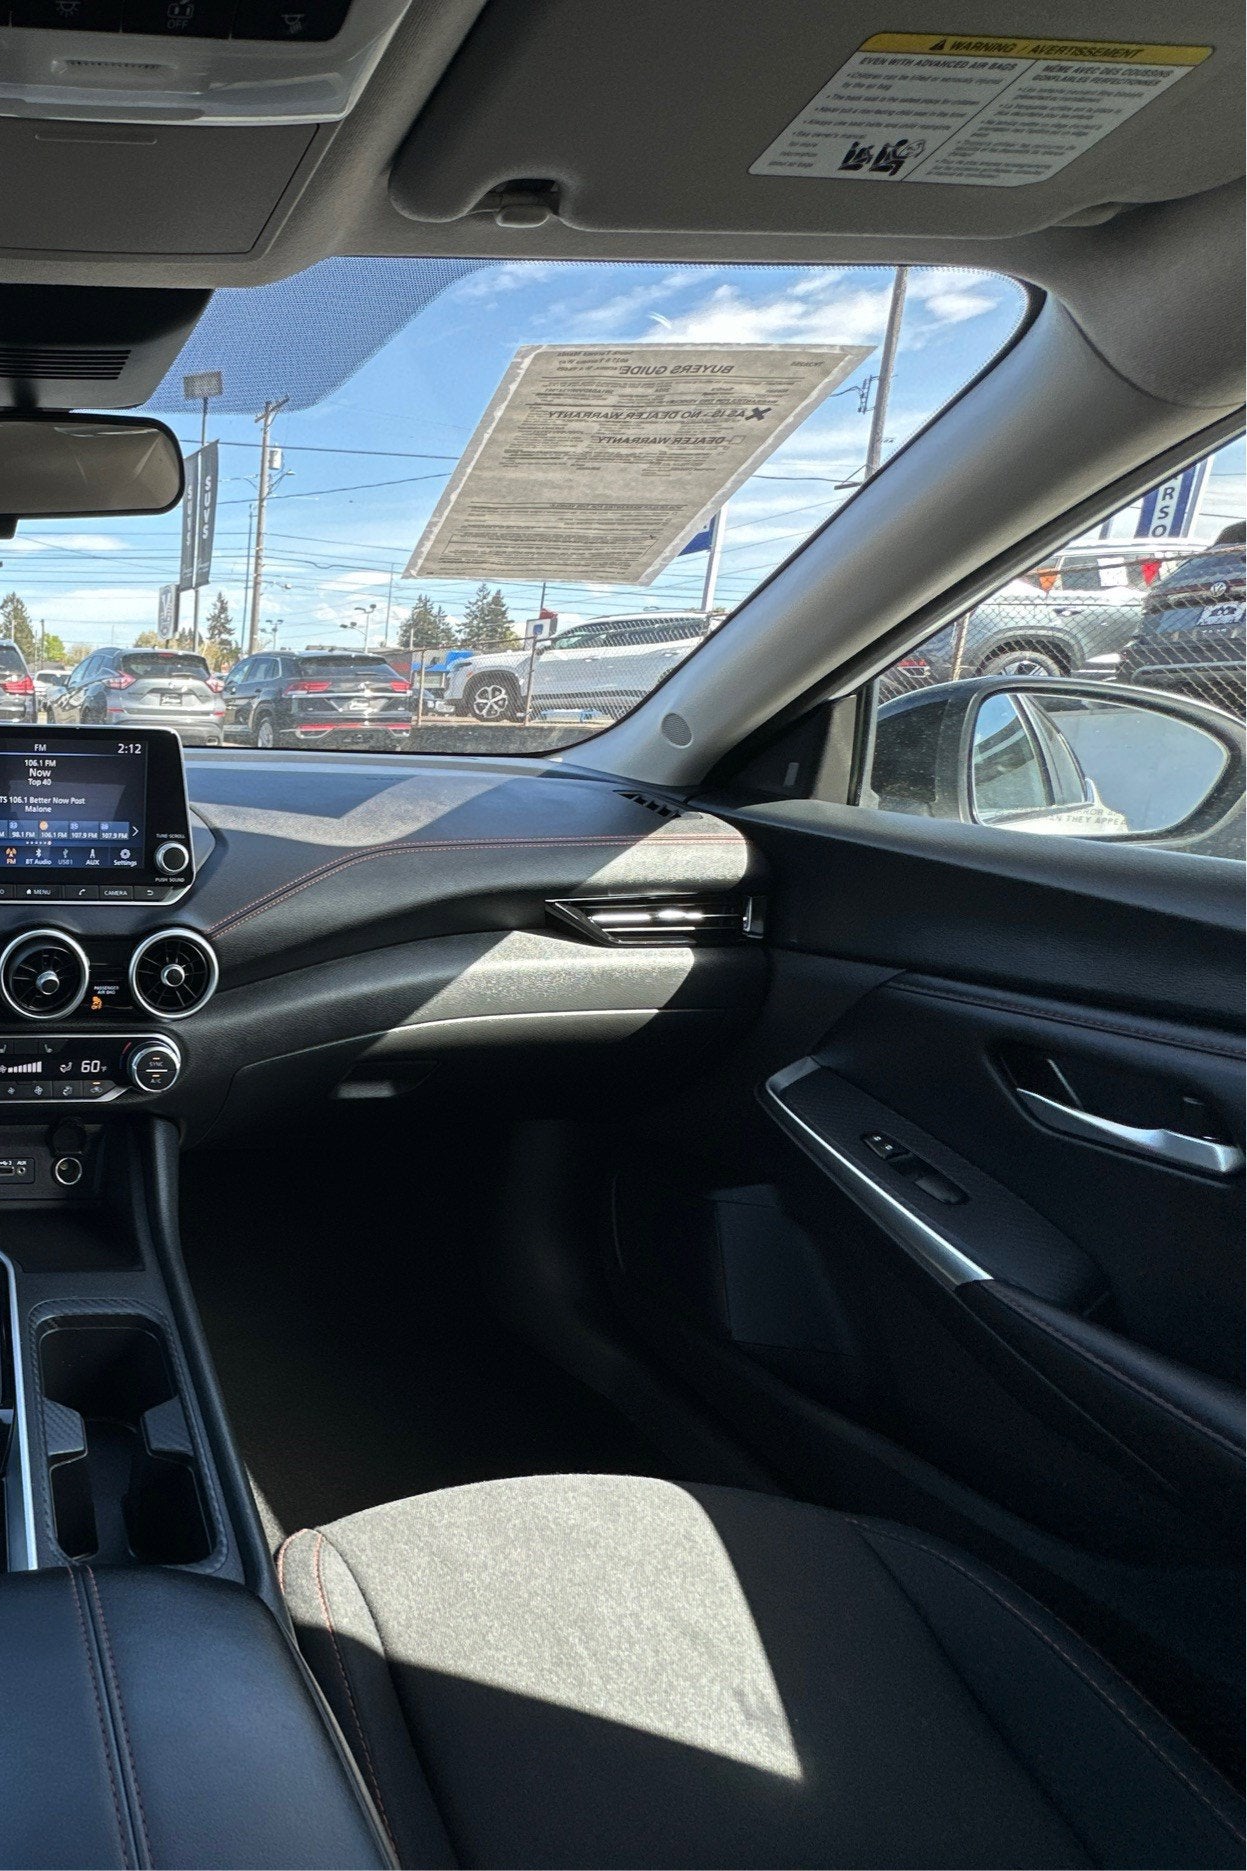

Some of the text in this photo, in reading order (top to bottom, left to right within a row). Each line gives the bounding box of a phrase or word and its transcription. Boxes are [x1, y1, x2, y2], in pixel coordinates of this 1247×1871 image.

[167, 19, 188, 30] OFF
[949, 40, 1145, 58] WARNING AVERTISSEMENT
[857, 56, 1019, 71] EVEN WITH ADVANCED AIR BAGS
[202, 475, 211, 540] SUVS
[1151, 477, 1178, 538] RSO
[34, 744, 47, 752] FM
[117, 744, 142, 754] 2:12
[24, 759, 43, 767] 106.1
[29, 768, 51, 777] Now
[28, 778, 52, 787] Top 40
[9, 796, 28, 804] 106.1
[70, 797, 85, 805] Post
[25, 804, 52, 813] Malone
[113, 859, 137, 867] Settings
